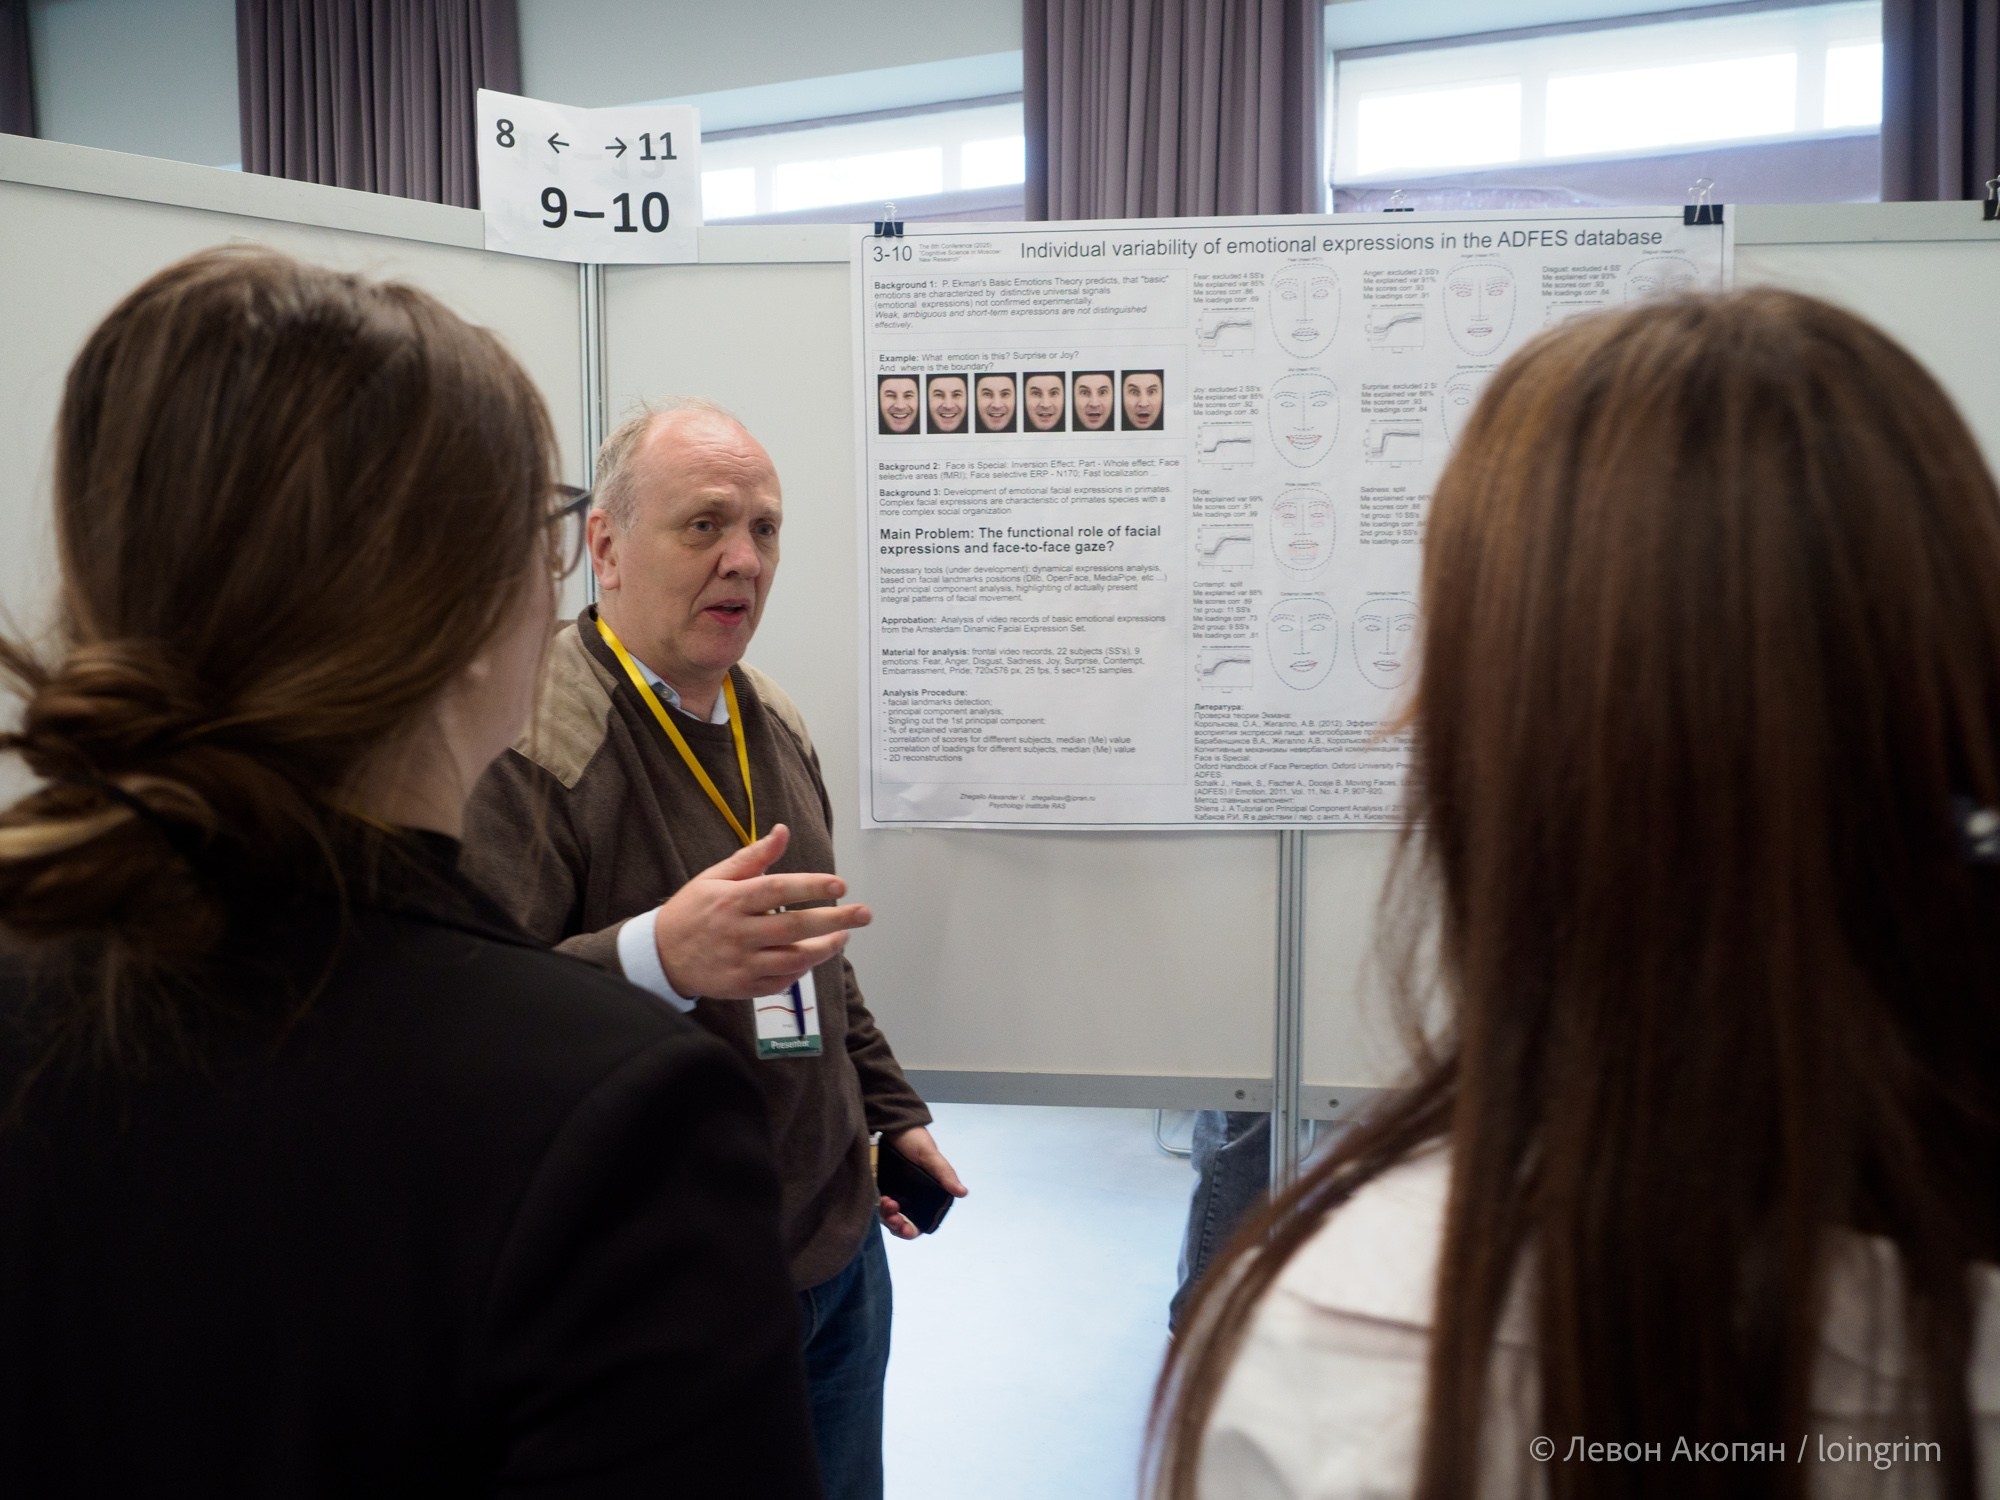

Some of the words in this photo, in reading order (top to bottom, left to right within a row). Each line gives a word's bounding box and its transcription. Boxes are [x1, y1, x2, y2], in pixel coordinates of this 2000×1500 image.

[496, 118, 515, 148] 8
[638, 132, 677, 160] 11
[1022, 240, 1105, 258] Individual
[1112, 238, 1198, 260] variability
[1204, 237, 1222, 254] of
[1227, 235, 1316, 253] emotional
[1323, 232, 1434, 255] expressions
[1441, 232, 1456, 249] in
[1463, 231, 1492, 248] the
[1497, 230, 1568, 247] ADFES
[1574, 227, 1662, 246] database
[873, 244, 912, 262] 3-10
[874, 281, 927, 290] Background
[952, 279, 987, 287] Ekman's
[1014, 278, 1052, 286] Emotions
[1054, 277, 1083, 287] Theory
[874, 291, 911, 299] emotions
[929, 289, 983, 298] characterized
[986, 289, 996, 298] by
[1000, 288, 1041, 296] distinctive
[1043, 287, 1080, 295] universal
[1082, 286, 1111, 296] signals
[874, 301, 917, 310] (emotional
[921, 299, 973, 309] expressions)
[990, 298, 1030, 306] confirmed
[903, 310, 947, 319] ambiguous
[967, 308, 1008, 316] short-term
[1010, 307, 1060, 317] expressions
[1093, 306, 1147, 315] distinguished
[947, 353, 980, 361] emotion
[1013, 352, 1047, 361] Surprise
[1060, 351, 1079, 360] Joy?
[951, 362, 994, 372] boundary?
[879, 488, 931, 498] Background
[944, 487, 997, 497] Development
[1074, 486, 1123, 495] expressions
[879, 498, 915, 508] Complex
[939, 497, 988, 507] expressions
[1005, 496, 1059, 504] characteristic
[1071, 496, 1106, 505] primates
[1108, 495, 1140, 504] species
[902, 508, 935, 517] complex
[962, 507, 1012, 516] organization
[880, 528, 911, 539] Main
[915, 528, 974, 539] Problem:
[979, 527, 1003, 538] The
[1007, 526, 1073, 538] functional
[1078, 526, 1103, 537] role
[1108, 526, 1122, 537] of
[1125, 526, 1160, 536] facial
[880, 543, 960, 556] expressions
[964, 542, 988, 553] and
[992, 541, 1071, 553] face-to-face
[1075, 541, 1114, 554] gaze?
[941, 616, 974, 625] Analysis
[1117, 614, 1166, 623] expressions
[882, 689, 919, 698] Analysis
